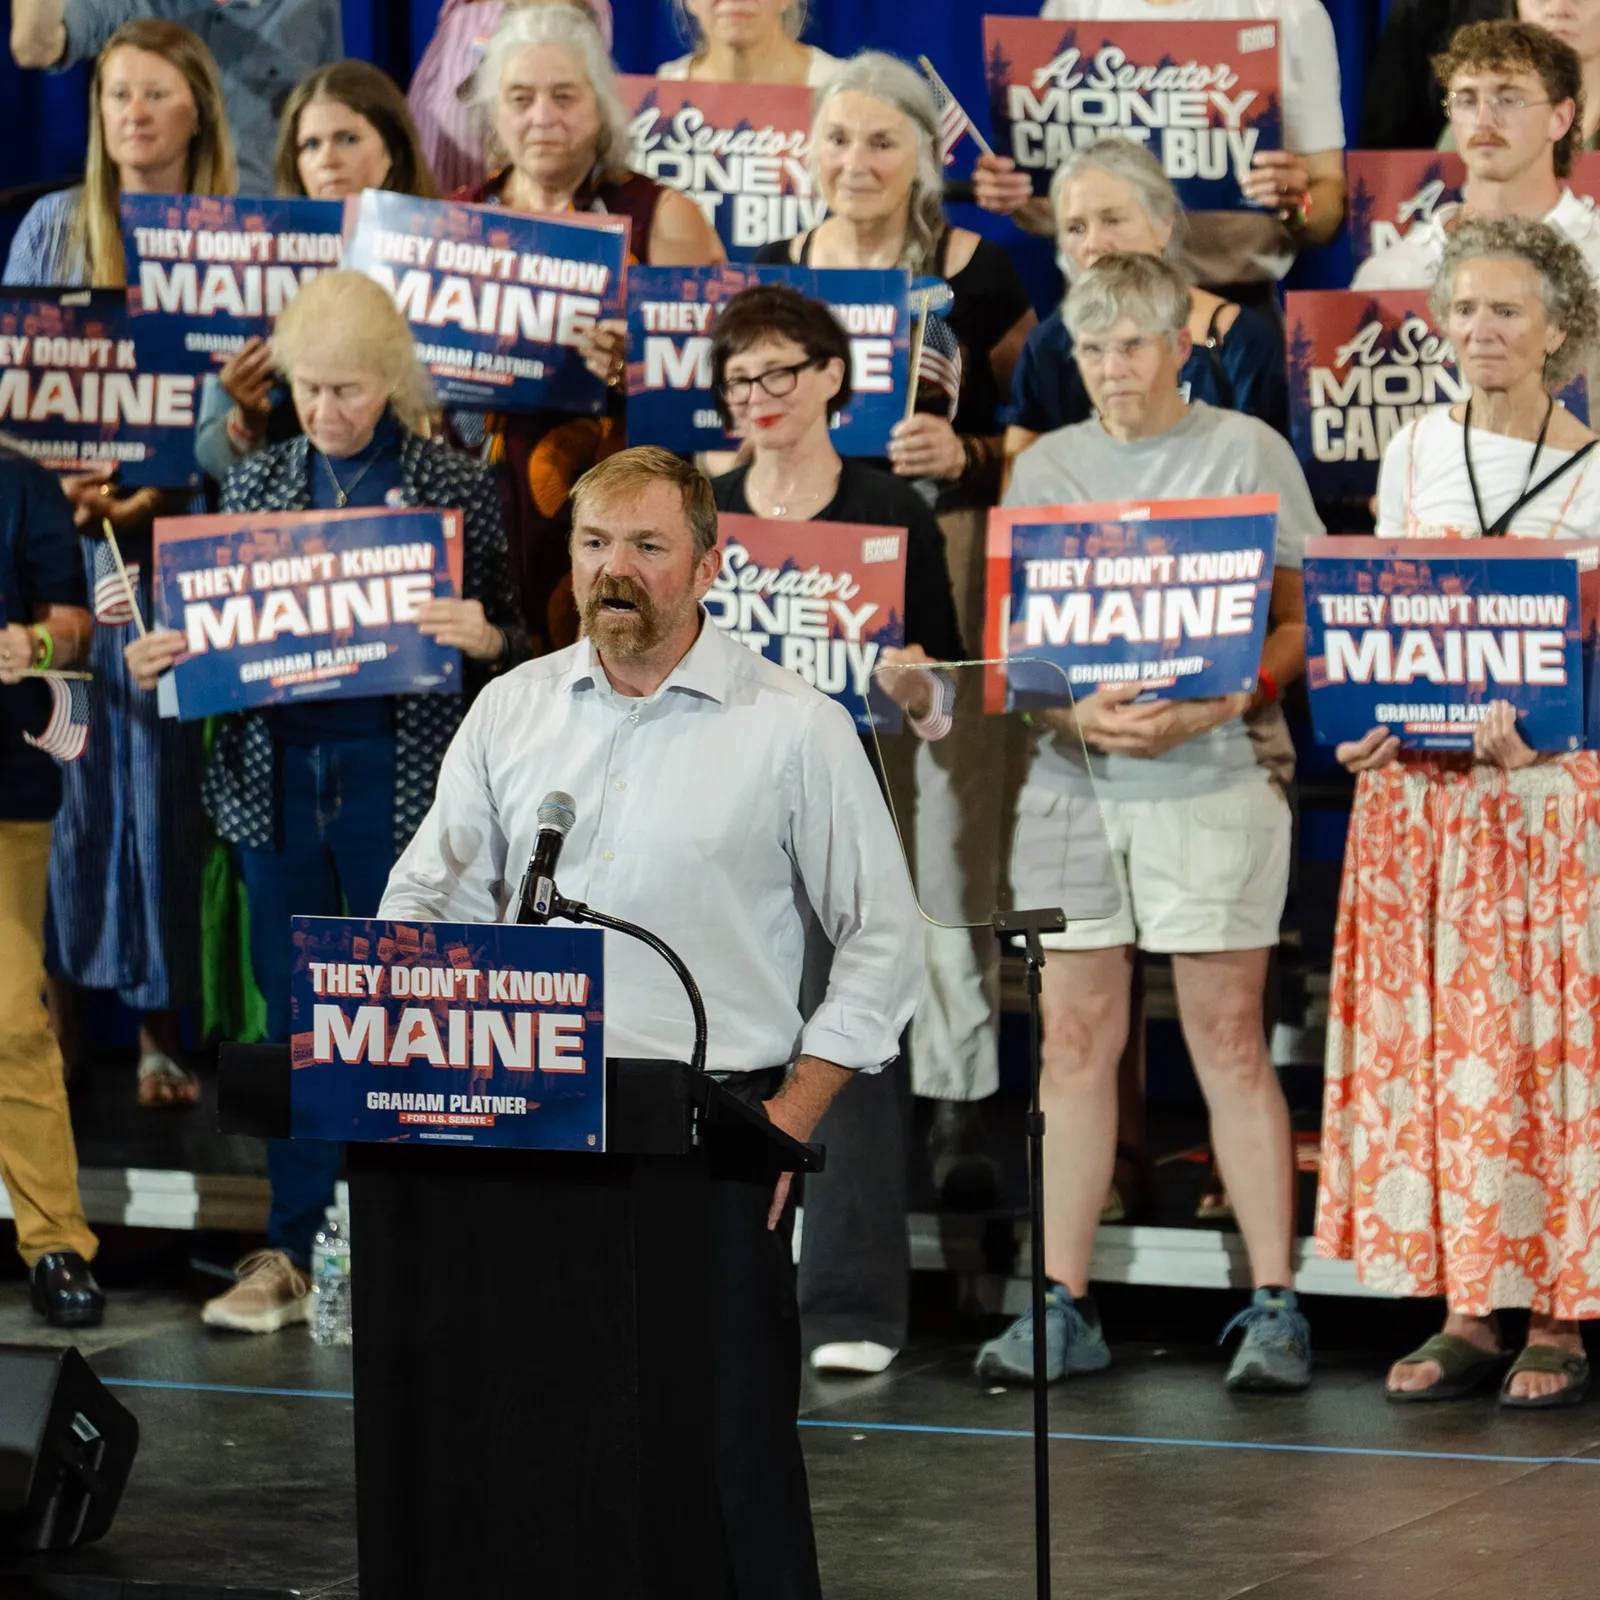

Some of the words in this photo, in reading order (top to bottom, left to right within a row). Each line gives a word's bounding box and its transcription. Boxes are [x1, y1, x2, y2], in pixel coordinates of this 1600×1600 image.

[1032, 47, 1084, 90] A
[1086, 46, 1239, 91] Senator
[1008, 85, 1259, 129] MONEY
[663, 107, 814, 154] Senator
[626, 150, 816, 196] ONEY
[1164, 127, 1260, 184] BUY
[134, 227, 193, 259] THEY
[196, 230, 274, 262] DON'T
[277, 232, 344, 264] KNO
[371, 229, 434, 267] THEY
[435, 240, 518, 280] DON'T
[518, 252, 610, 295] KNOW
[139, 260, 320, 318] MAIN
[368, 263, 602, 348] MAINE
[641, 301, 710, 333] THEY
[33, 336, 113, 368] DON'T
[474, 350, 545, 381] PLATNER
[1334, 320, 1386, 369] A
[1310, 363, 1474, 408] MON
[176, 564, 247, 600] THEY
[252, 552, 336, 589] DON'T
[342, 541, 433, 574] KNOW
[711, 543, 861, 601] Senator
[1025, 557, 1091, 590] THEY
[1094, 554, 1175, 587] DON'T
[1179, 547, 1264, 583] KNOW
[183, 573, 433, 653] MAINE
[699, 588, 880, 642] ONEY
[1025, 582, 1257, 646] MAINE
[1318, 593, 1387, 625] THEY
[1390, 593, 1473, 625] DON'T
[1476, 593, 1567, 626] KNOW
[239, 651, 313, 684] GRAHAM
[314, 640, 388, 670] PLATNER
[1067, 662, 1140, 684] GRAHAM
[1140, 656, 1204, 679] PLATNER
[1323, 628, 1566, 684] MAINE
[1375, 702, 1446, 723] GRAHAM
[308, 962, 384, 996] THEY
[391, 965, 481, 999] DON'T
[488, 969, 588, 1003] KNOW
[312, 1003, 585, 1071] MAINE
[366, 1091, 445, 1112] GRAHAM
[450, 1094, 527, 1115] PLATNER
[406, 1114, 427, 1123] FOR
[428, 1115, 447, 1124] U.S.
[448, 1115, 487, 1125] SENATE
